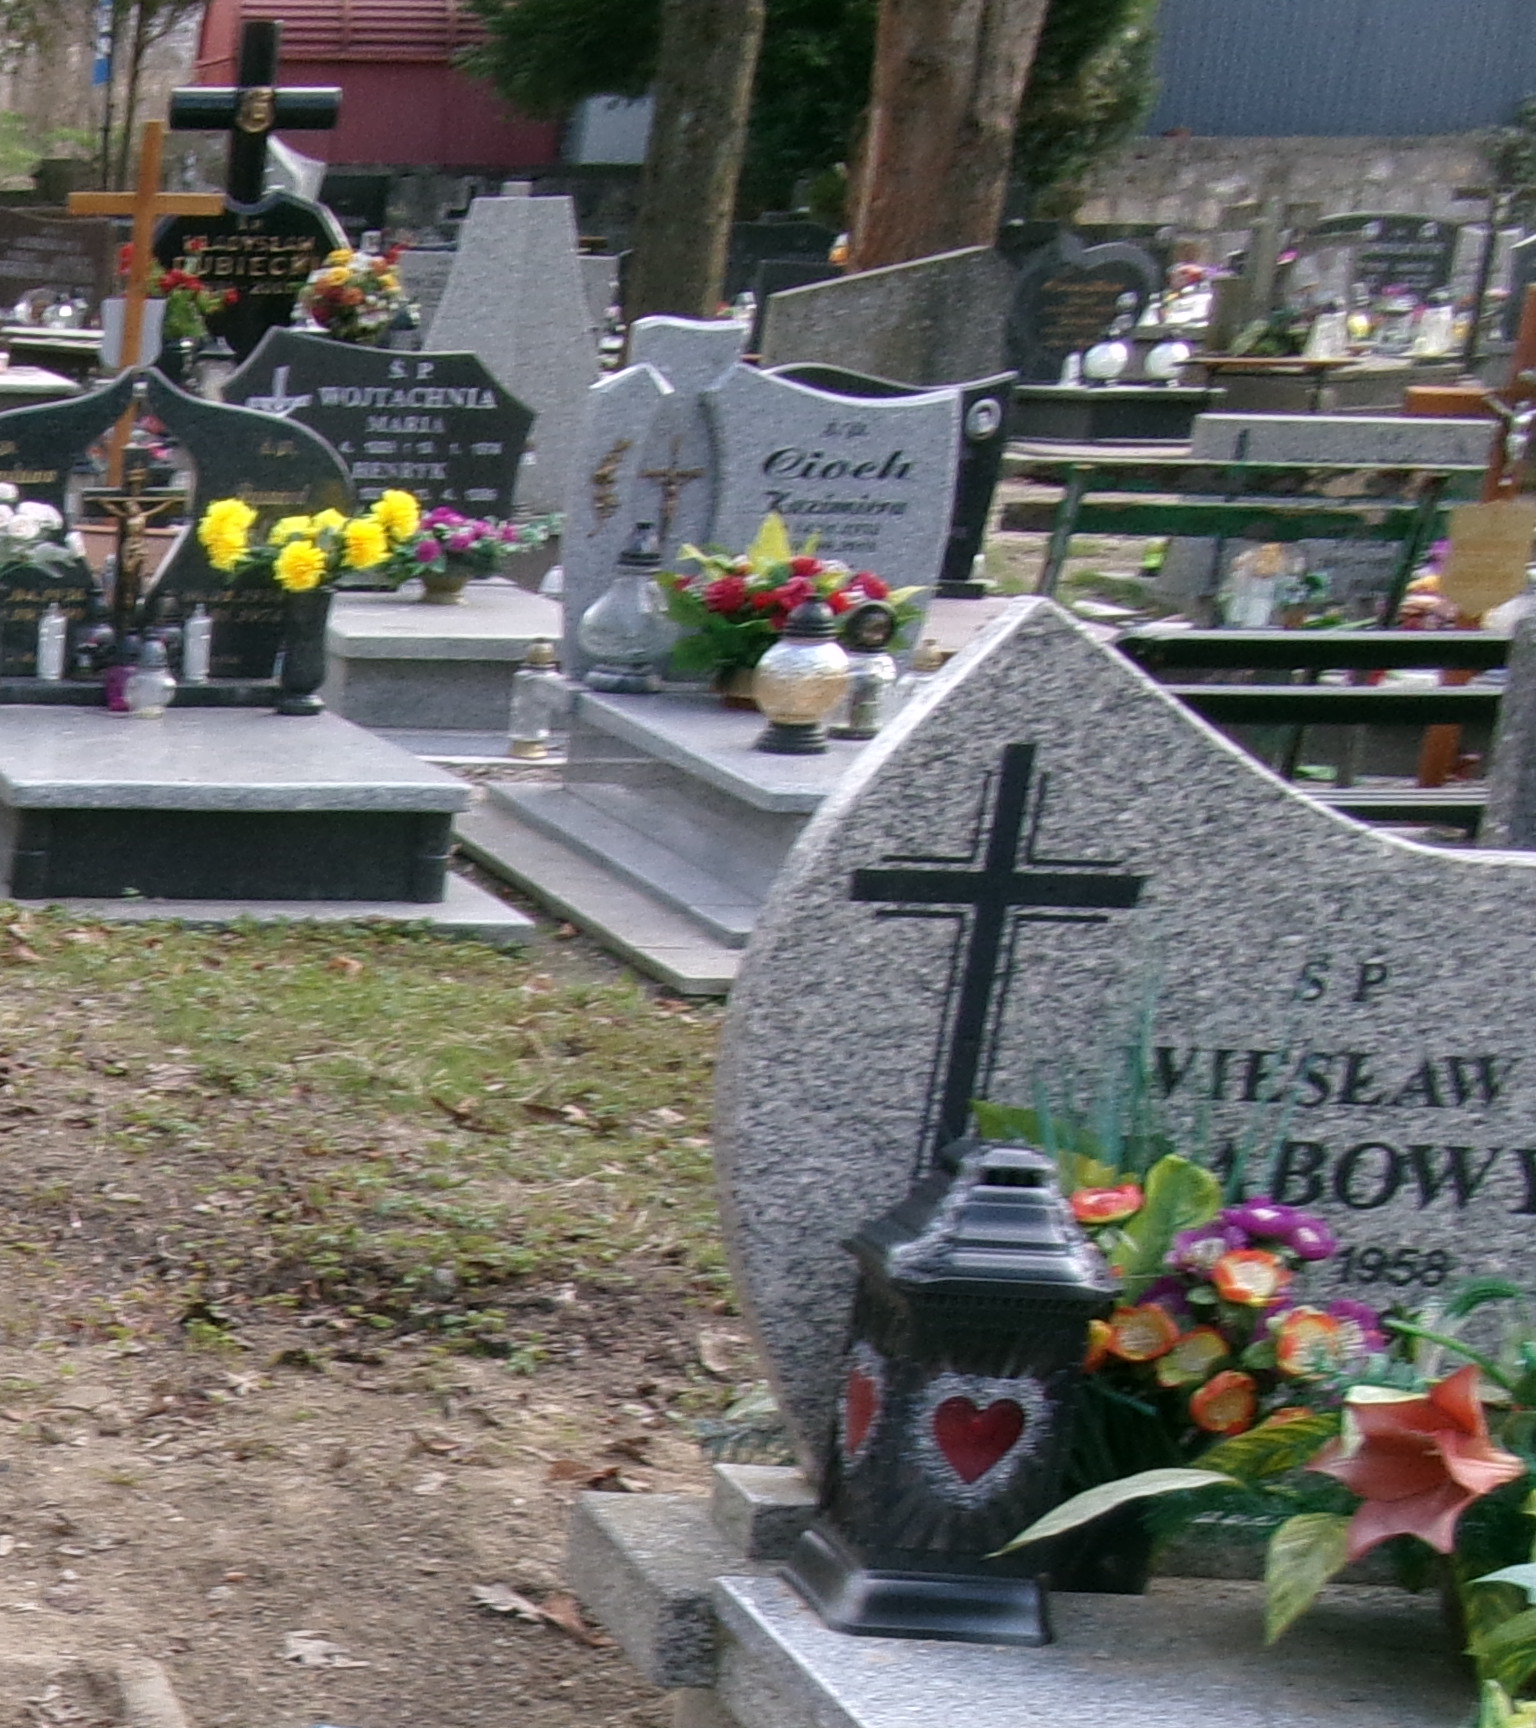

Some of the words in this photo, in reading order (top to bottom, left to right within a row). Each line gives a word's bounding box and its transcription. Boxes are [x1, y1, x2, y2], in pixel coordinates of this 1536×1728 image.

[317, 386, 498, 409] WOJTACHNIA
[365, 414, 445, 433] MARIA
[1336, 1246, 1452, 1287] 1958
